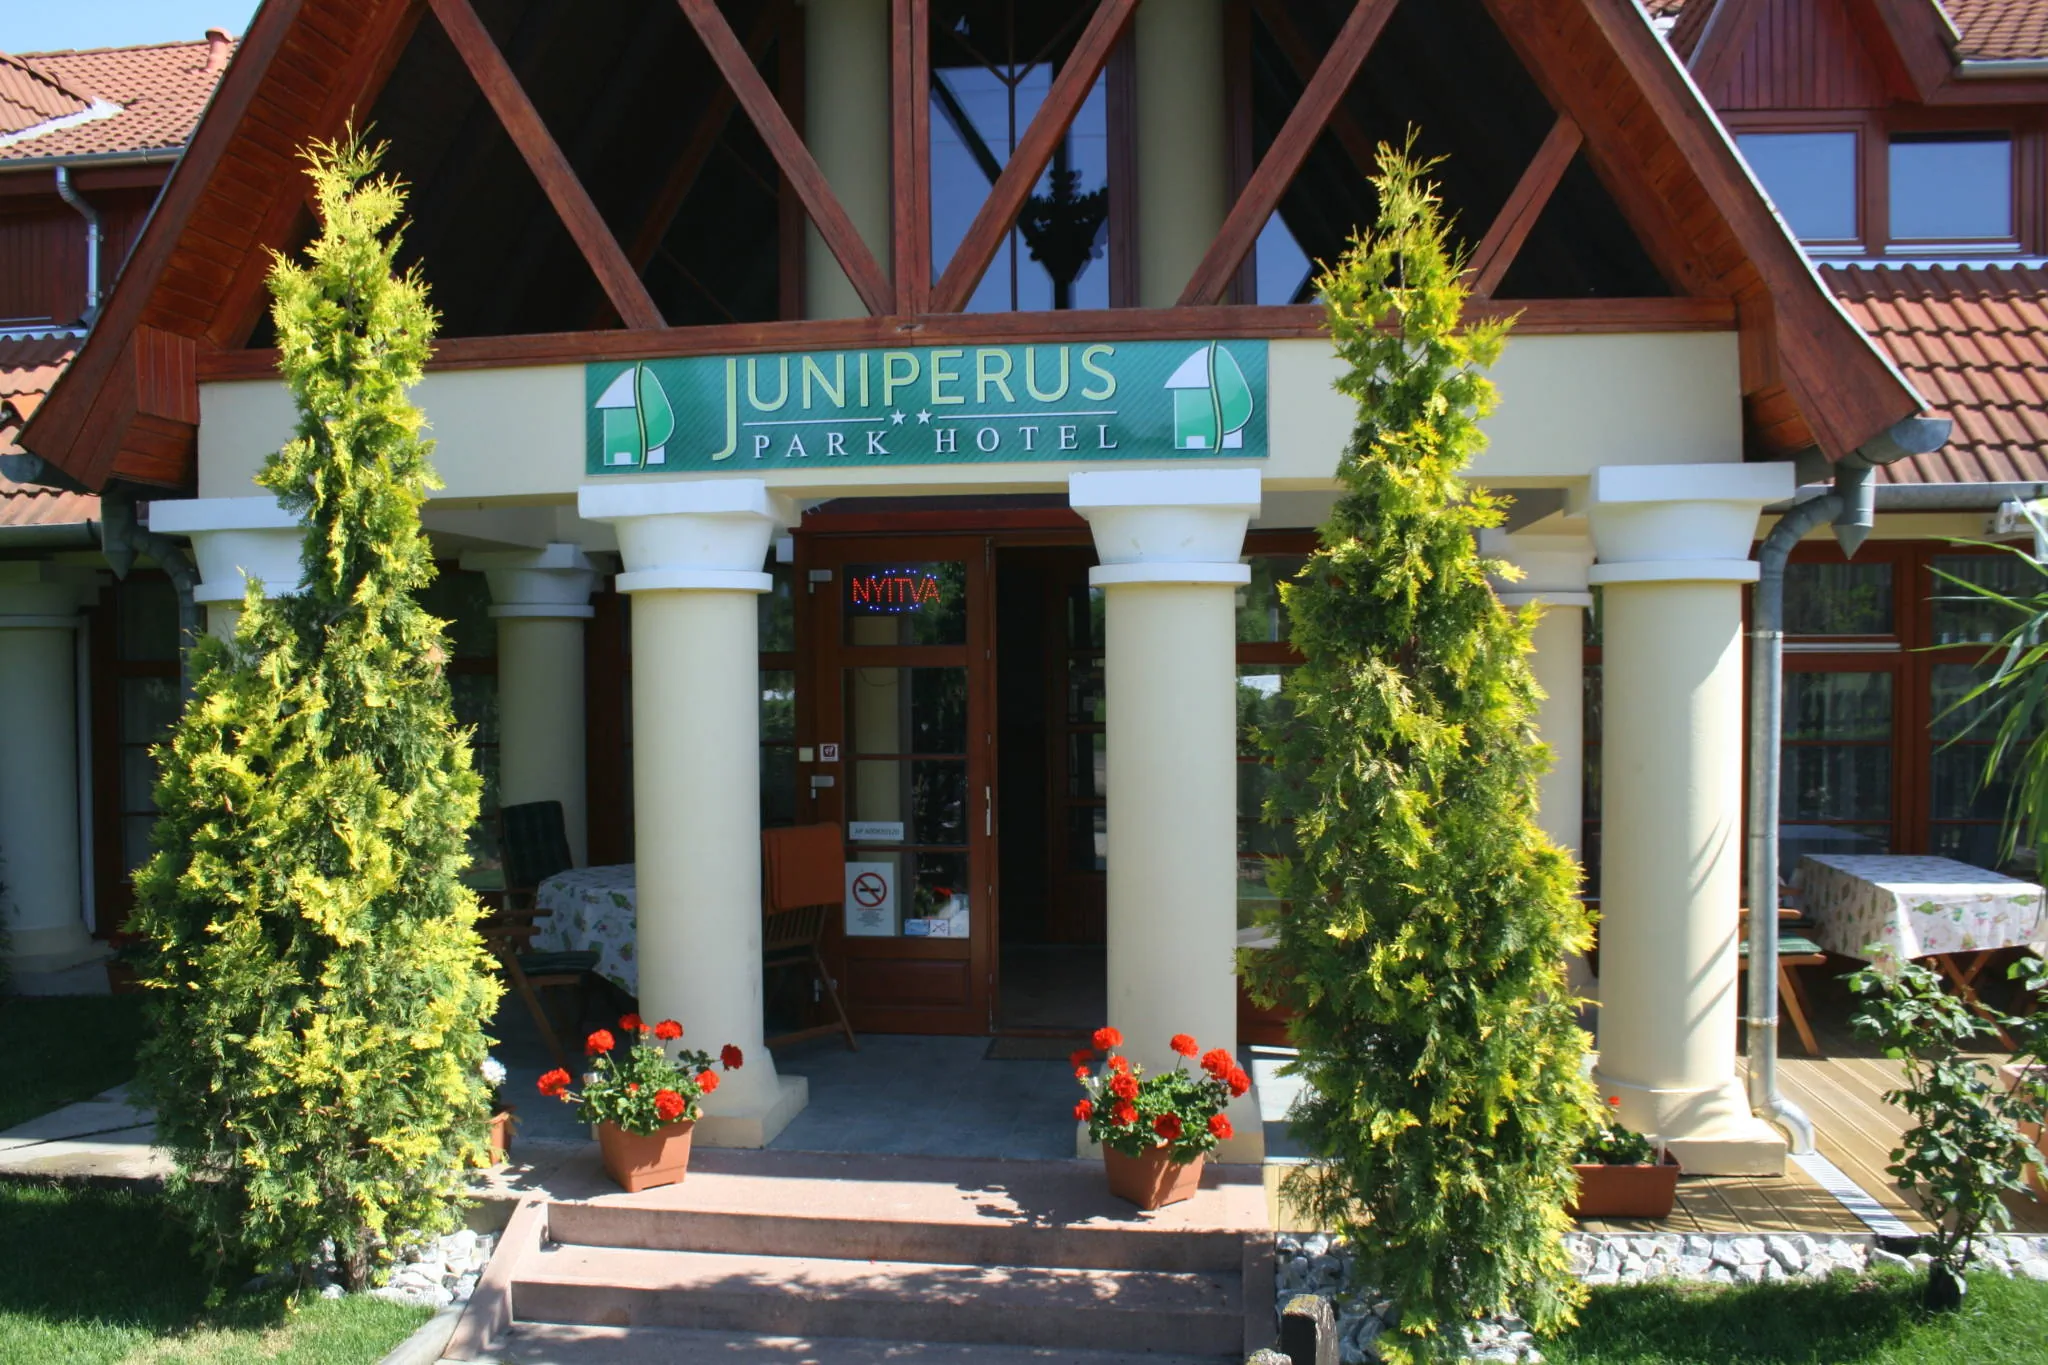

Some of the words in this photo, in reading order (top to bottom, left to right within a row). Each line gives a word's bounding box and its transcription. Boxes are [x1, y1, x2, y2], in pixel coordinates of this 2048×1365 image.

[712, 344, 1117, 461] JUNIPERUS
[754, 431, 890, 459] PARK
[934, 425, 1119, 453] HOTEL
[852, 577, 941, 603] NYITVA
